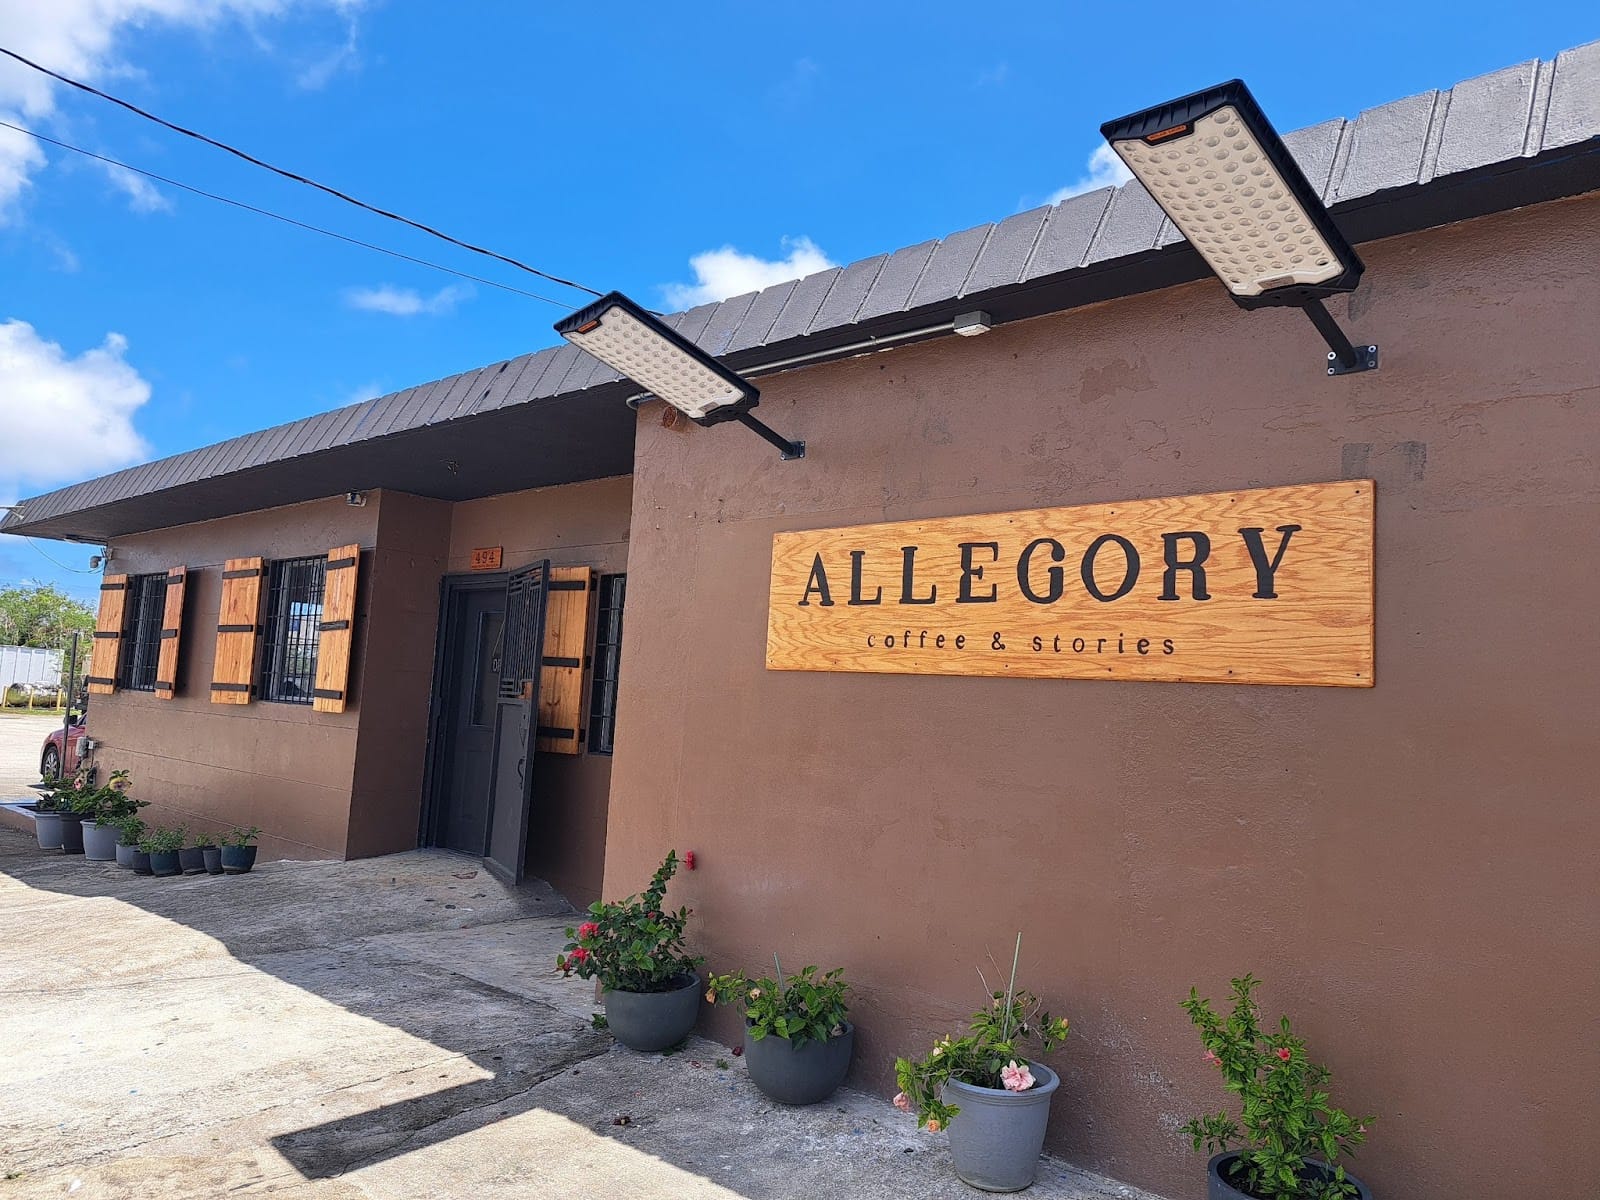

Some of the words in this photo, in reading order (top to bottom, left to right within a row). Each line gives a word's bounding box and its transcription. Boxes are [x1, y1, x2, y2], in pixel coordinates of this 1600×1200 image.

[475, 551, 496, 564] 494
[798, 524, 1302, 607] ALLEGORY
[867, 631, 966, 650] coffee
[991, 631, 1006, 651] &
[1032, 633, 1175, 655] stories
